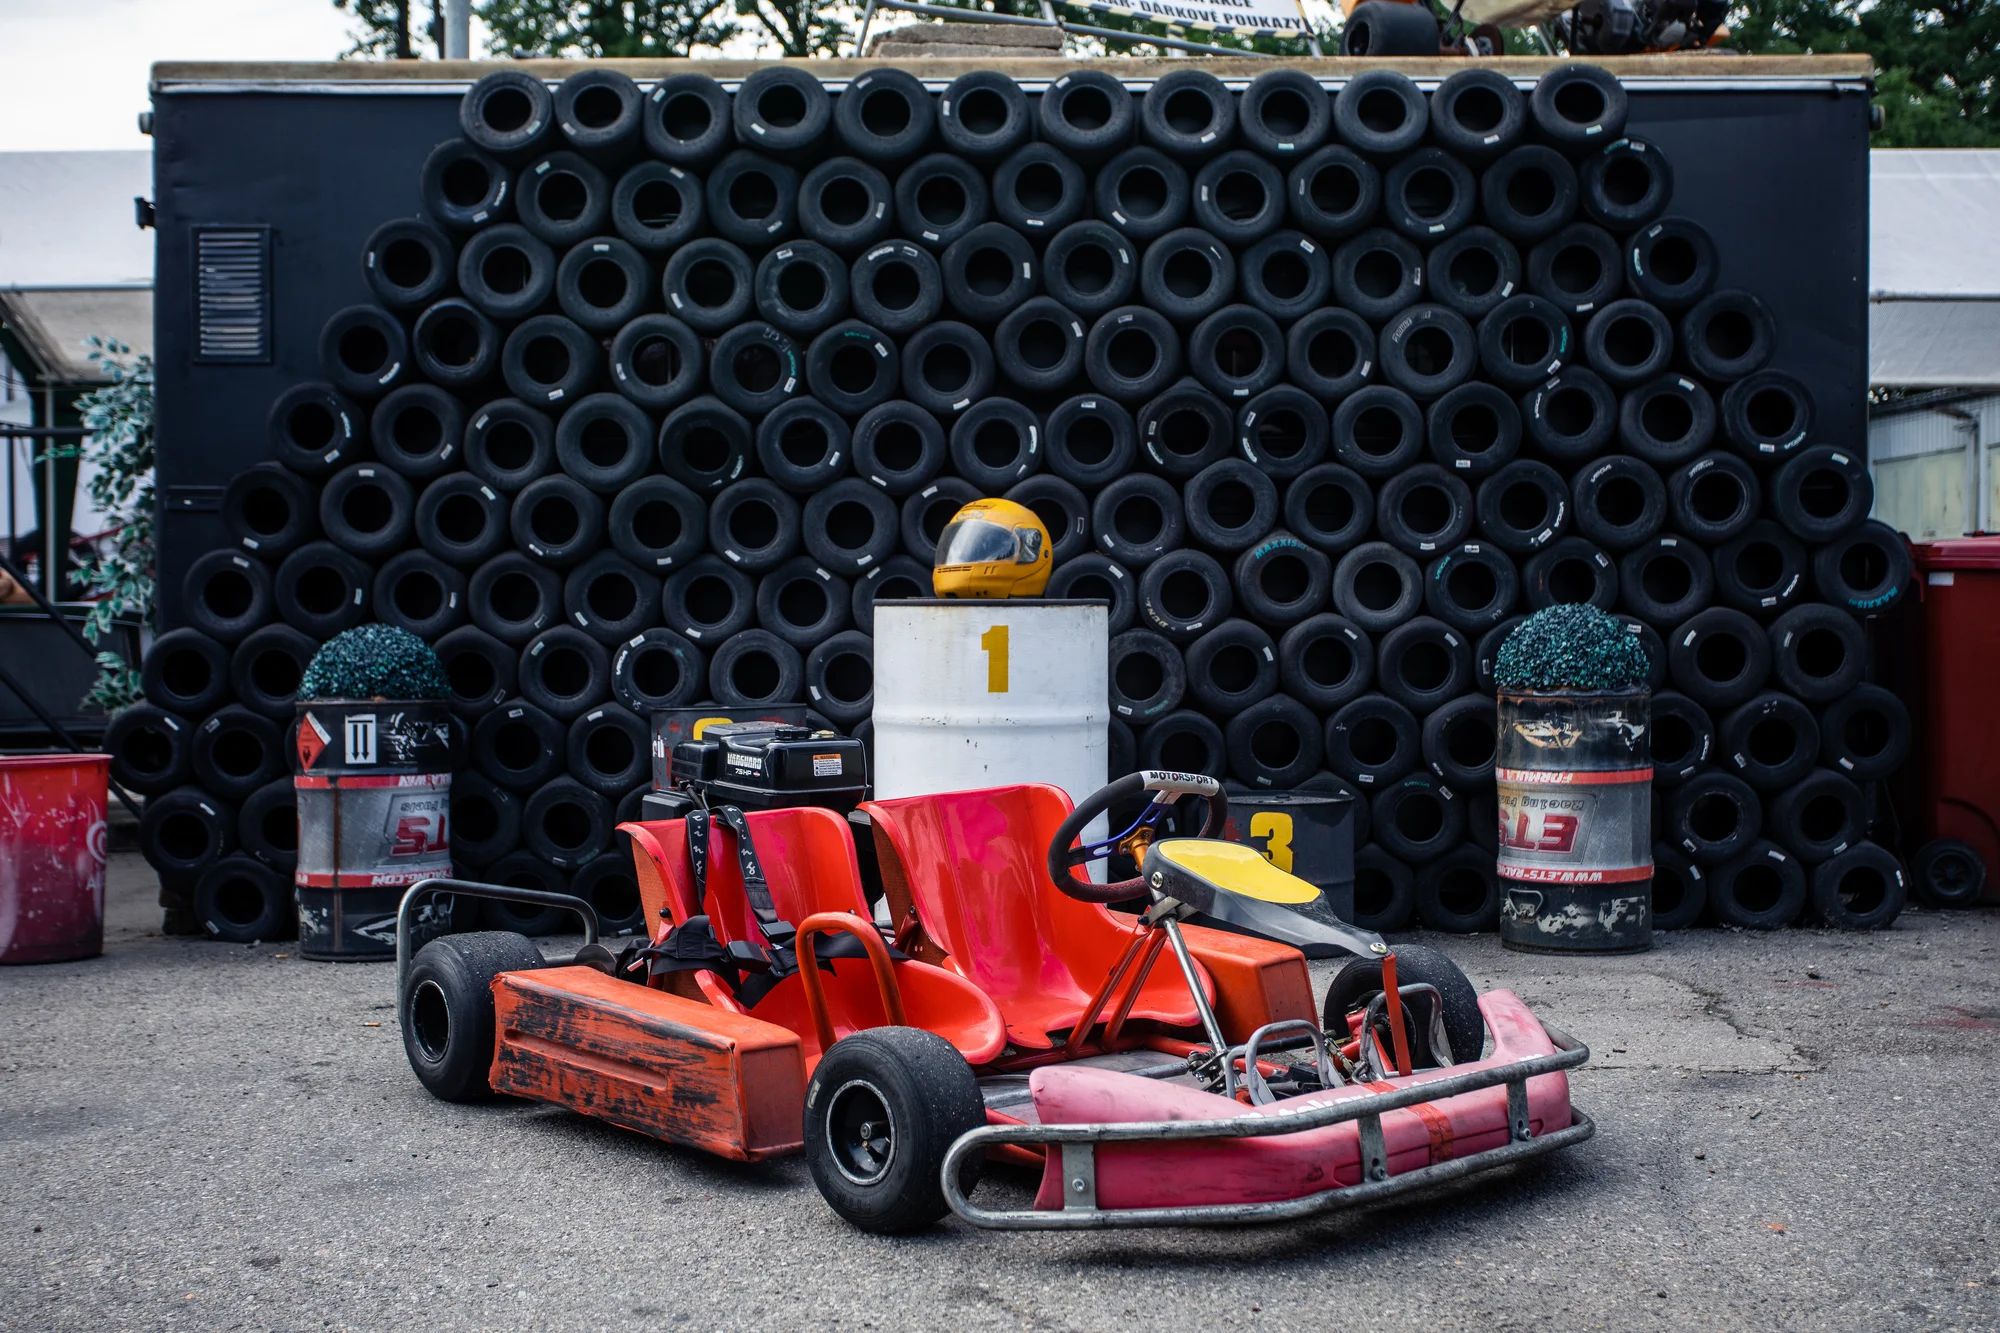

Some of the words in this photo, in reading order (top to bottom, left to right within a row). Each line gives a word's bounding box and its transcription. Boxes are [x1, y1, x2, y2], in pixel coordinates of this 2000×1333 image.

[1140, 1, 1218, 23] DÁRKOVÉ
[1223, 12, 1302, 30] POUKAZY
[1255, 538, 1298, 560] MAXXIS
[1857, 586, 1898, 609] MAXXIS
[981, 625, 1009, 693] 1
[1149, 771, 1214, 785] MOTORSPORT
[1507, 769, 1573, 783] FORMULA
[389, 813, 448, 857] TS
[1249, 811, 1294, 873] 3
